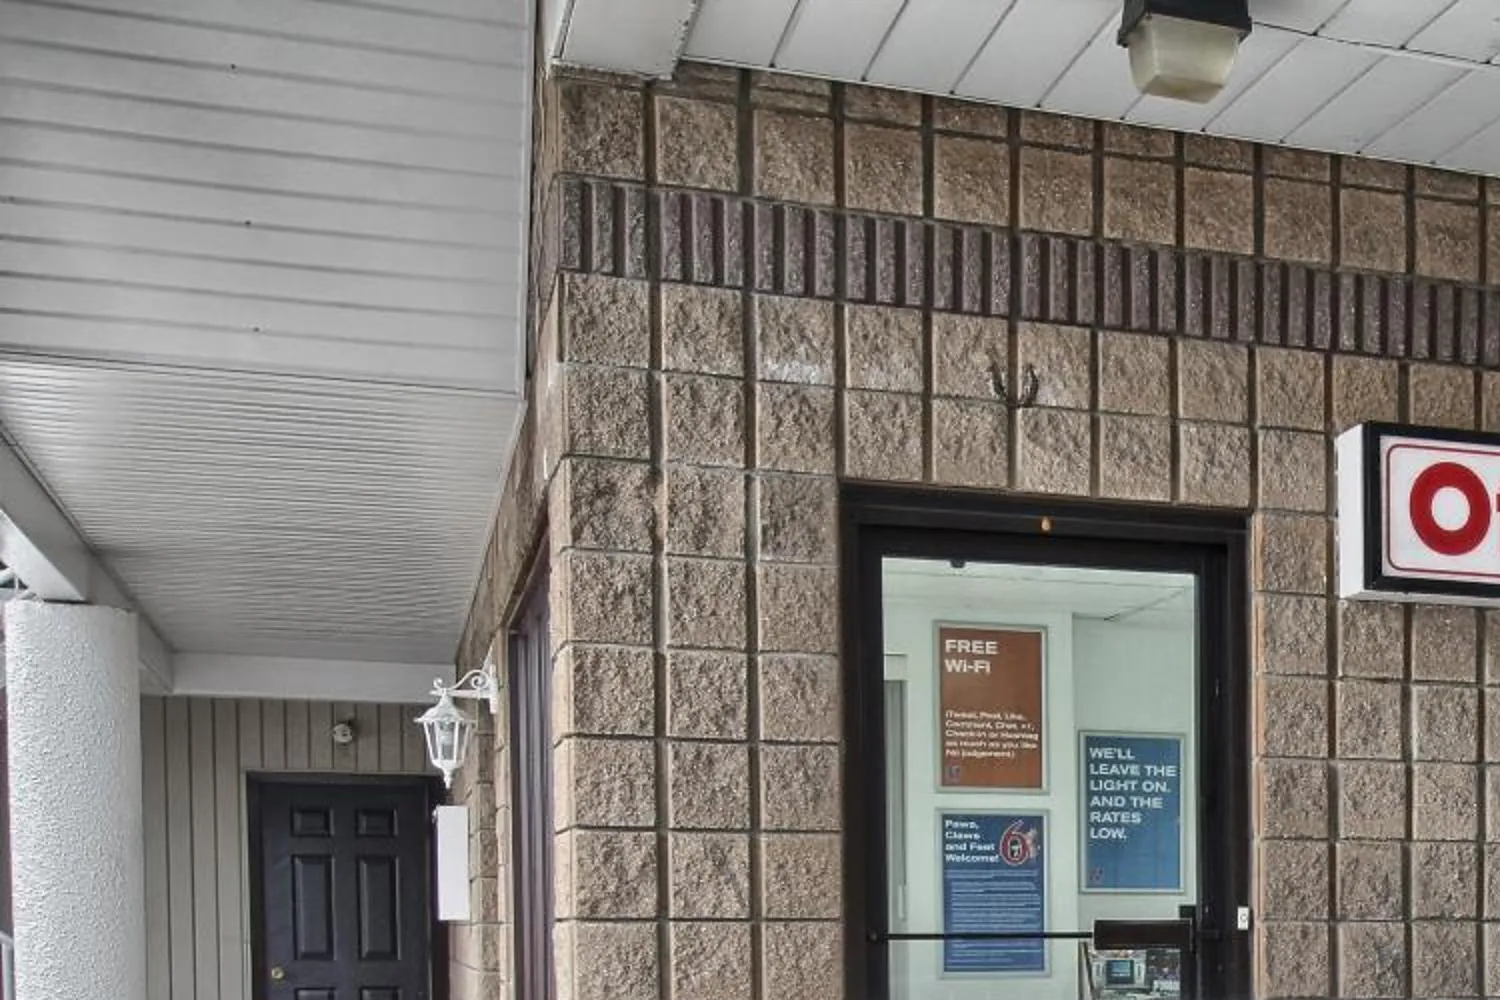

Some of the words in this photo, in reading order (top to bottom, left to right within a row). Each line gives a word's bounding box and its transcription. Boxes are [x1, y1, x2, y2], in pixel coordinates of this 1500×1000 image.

[945, 639, 998, 655] FREE
[1089, 747, 1135, 760] WE'LL
[1089, 763, 1140, 776] LEAVE
[1144, 765, 1177, 777] THE
[1089, 779, 1138, 792] LIGHT
[1142, 781, 1171, 793] ON.
[1089, 796, 1126, 808] AND
[1130, 797, 1164, 809] THE
[1089, 812, 1142, 825] RATES
[1089, 828, 1128, 840] LOW.
[945, 843, 967, 851] and
